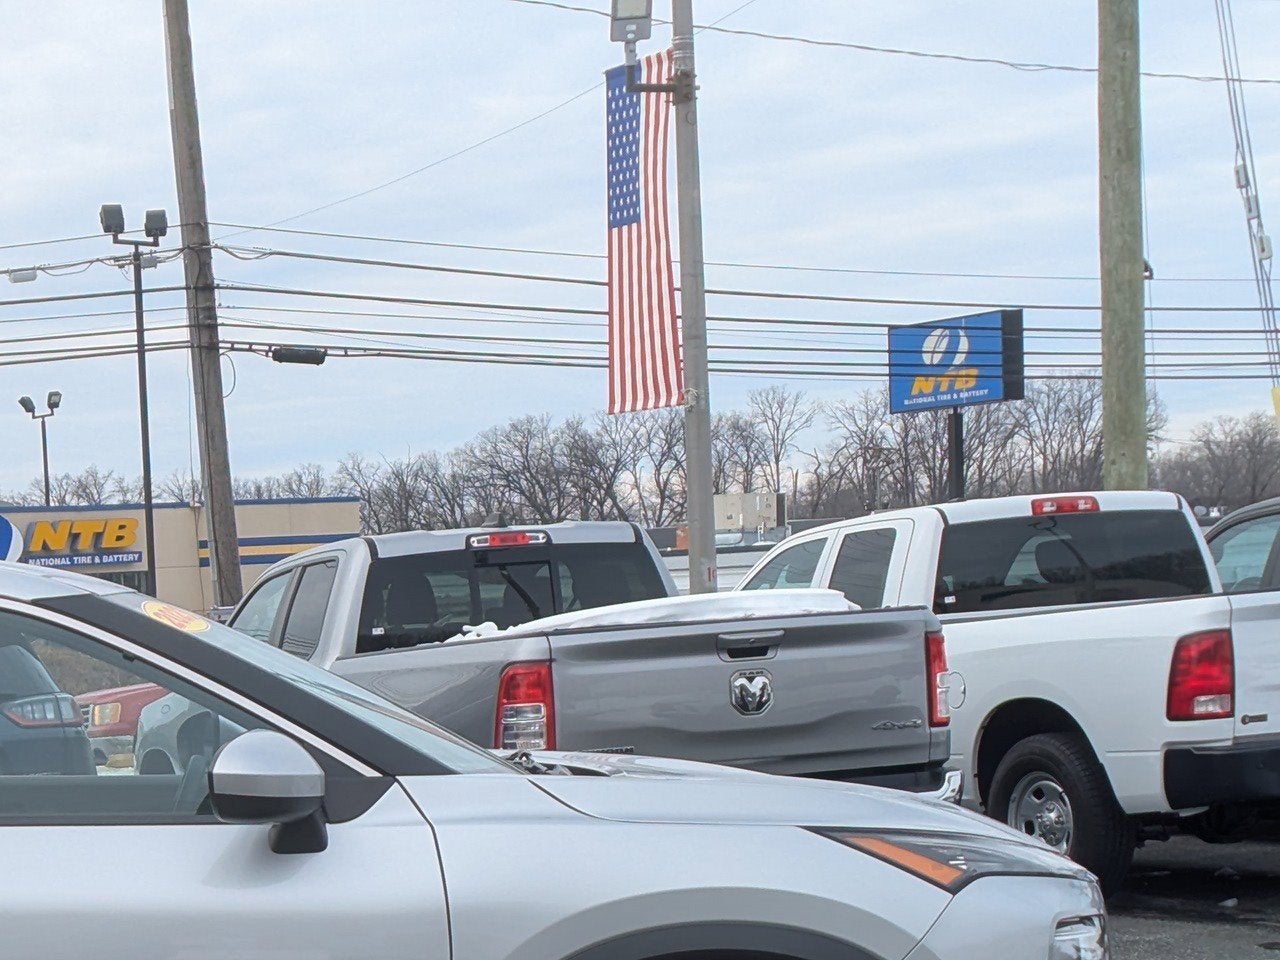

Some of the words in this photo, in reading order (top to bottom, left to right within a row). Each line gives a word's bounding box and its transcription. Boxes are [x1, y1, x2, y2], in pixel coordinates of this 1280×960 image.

[911, 368, 978, 395] NTB
[29, 518, 140, 552] NTB
[28, 556, 71, 566] NATIONAL
[73, 555, 92, 564] TIRE
[94, 555, 100, 564] &
[102, 553, 139, 563] BATTERY
